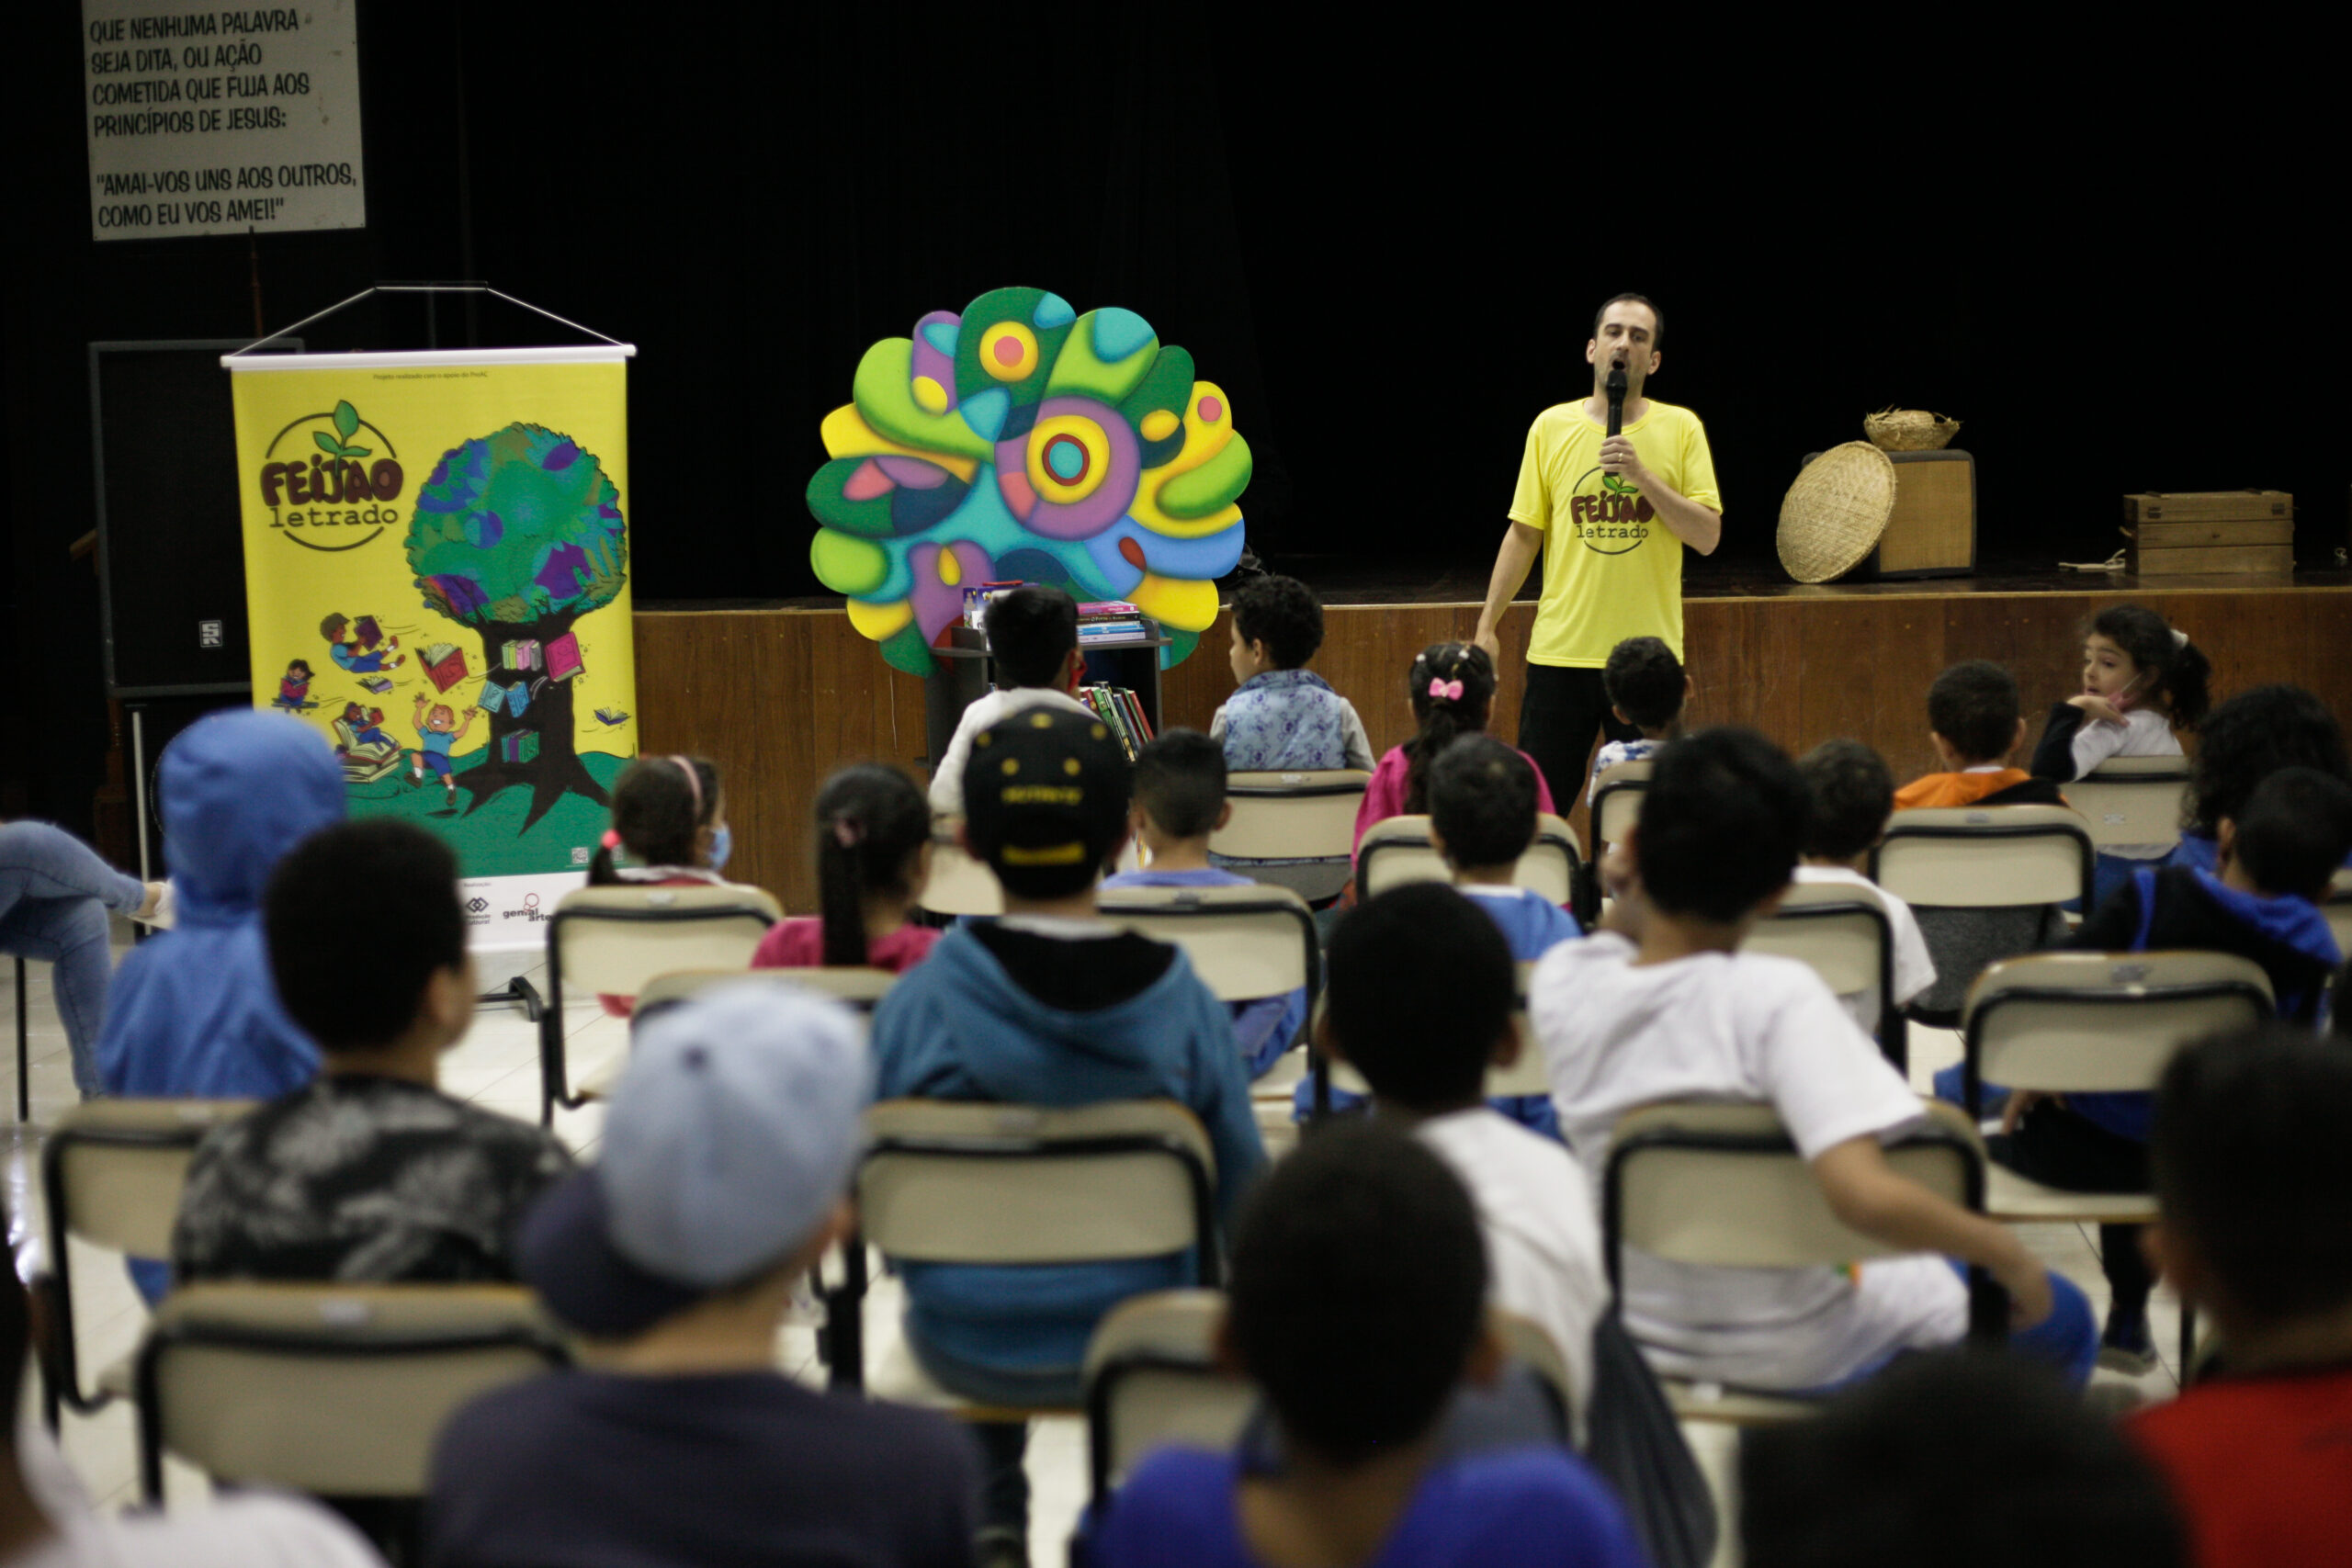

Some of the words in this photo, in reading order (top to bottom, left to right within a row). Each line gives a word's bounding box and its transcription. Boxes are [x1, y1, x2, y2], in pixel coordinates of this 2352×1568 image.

[89, 19, 125, 45] QUE
[130, 14, 217, 40] NENHUMA
[222, 8, 299, 34] PALAVRA
[91, 50, 131, 73] SEJA
[138, 48, 178, 72] DITA,
[184, 46, 209, 69] OU
[215, 39, 262, 72] AÇÃO
[93, 79, 181, 106] COMETIDA
[186, 76, 221, 103] QUE
[227, 73, 268, 97] FUJA
[273, 73, 310, 95] AOS
[94, 107, 194, 137] PRINCÍPIOS
[199, 109, 221, 131] DE
[227, 106, 287, 130] JESUS:
[96, 170, 190, 196] "AMAI-VOS
[195, 168, 232, 191] UNS
[237, 166, 273, 189] AOS
[277, 163, 356, 186] OUTROS,
[98, 204, 152, 228] COMO
[157, 203, 180, 226] EU
[185, 200, 221, 223] VOS
[226, 197, 284, 221] AMEI!"
[269, 505, 399, 528] letrado
[1577, 525, 1648, 538] letrado
